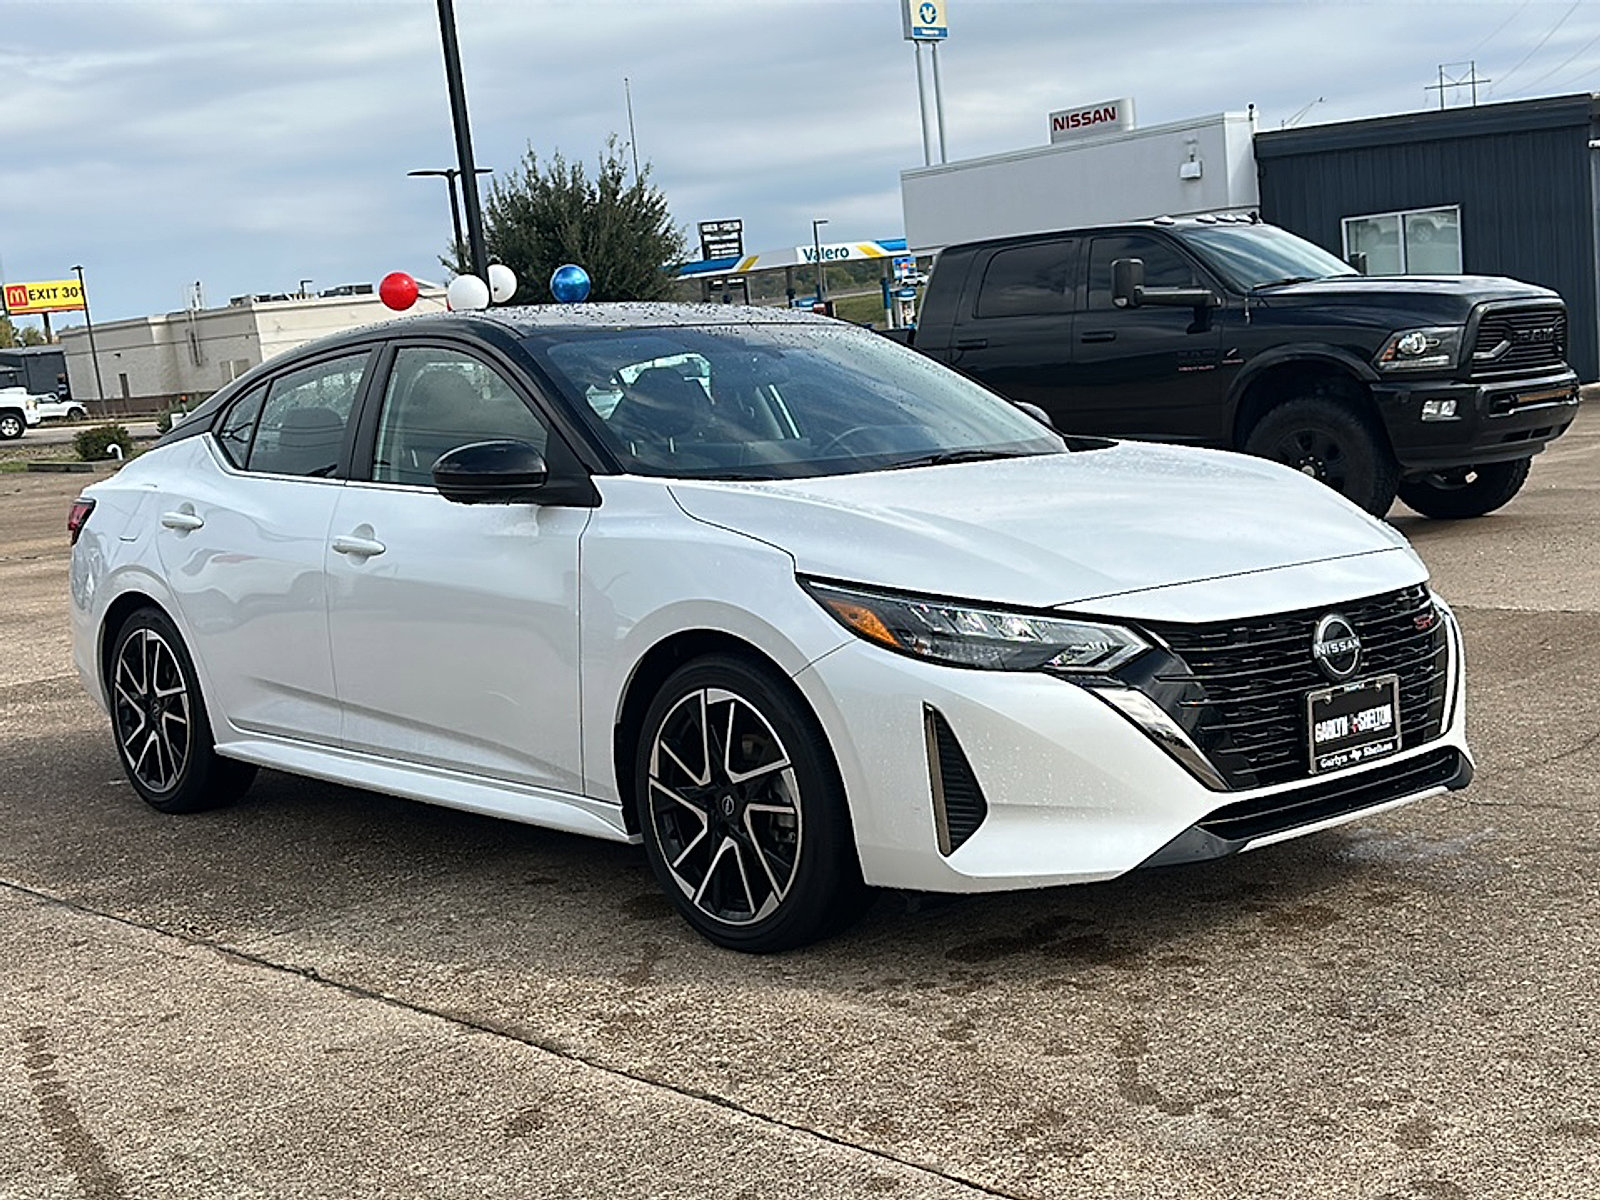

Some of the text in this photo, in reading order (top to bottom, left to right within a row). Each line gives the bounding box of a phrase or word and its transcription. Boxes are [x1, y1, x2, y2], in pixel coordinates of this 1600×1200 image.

[1053, 106, 1117, 132] NISSAN
[802, 246, 849, 262] Valero
[28, 288, 58, 300] EXIT
[1314, 636, 1360, 657] NISSAN
